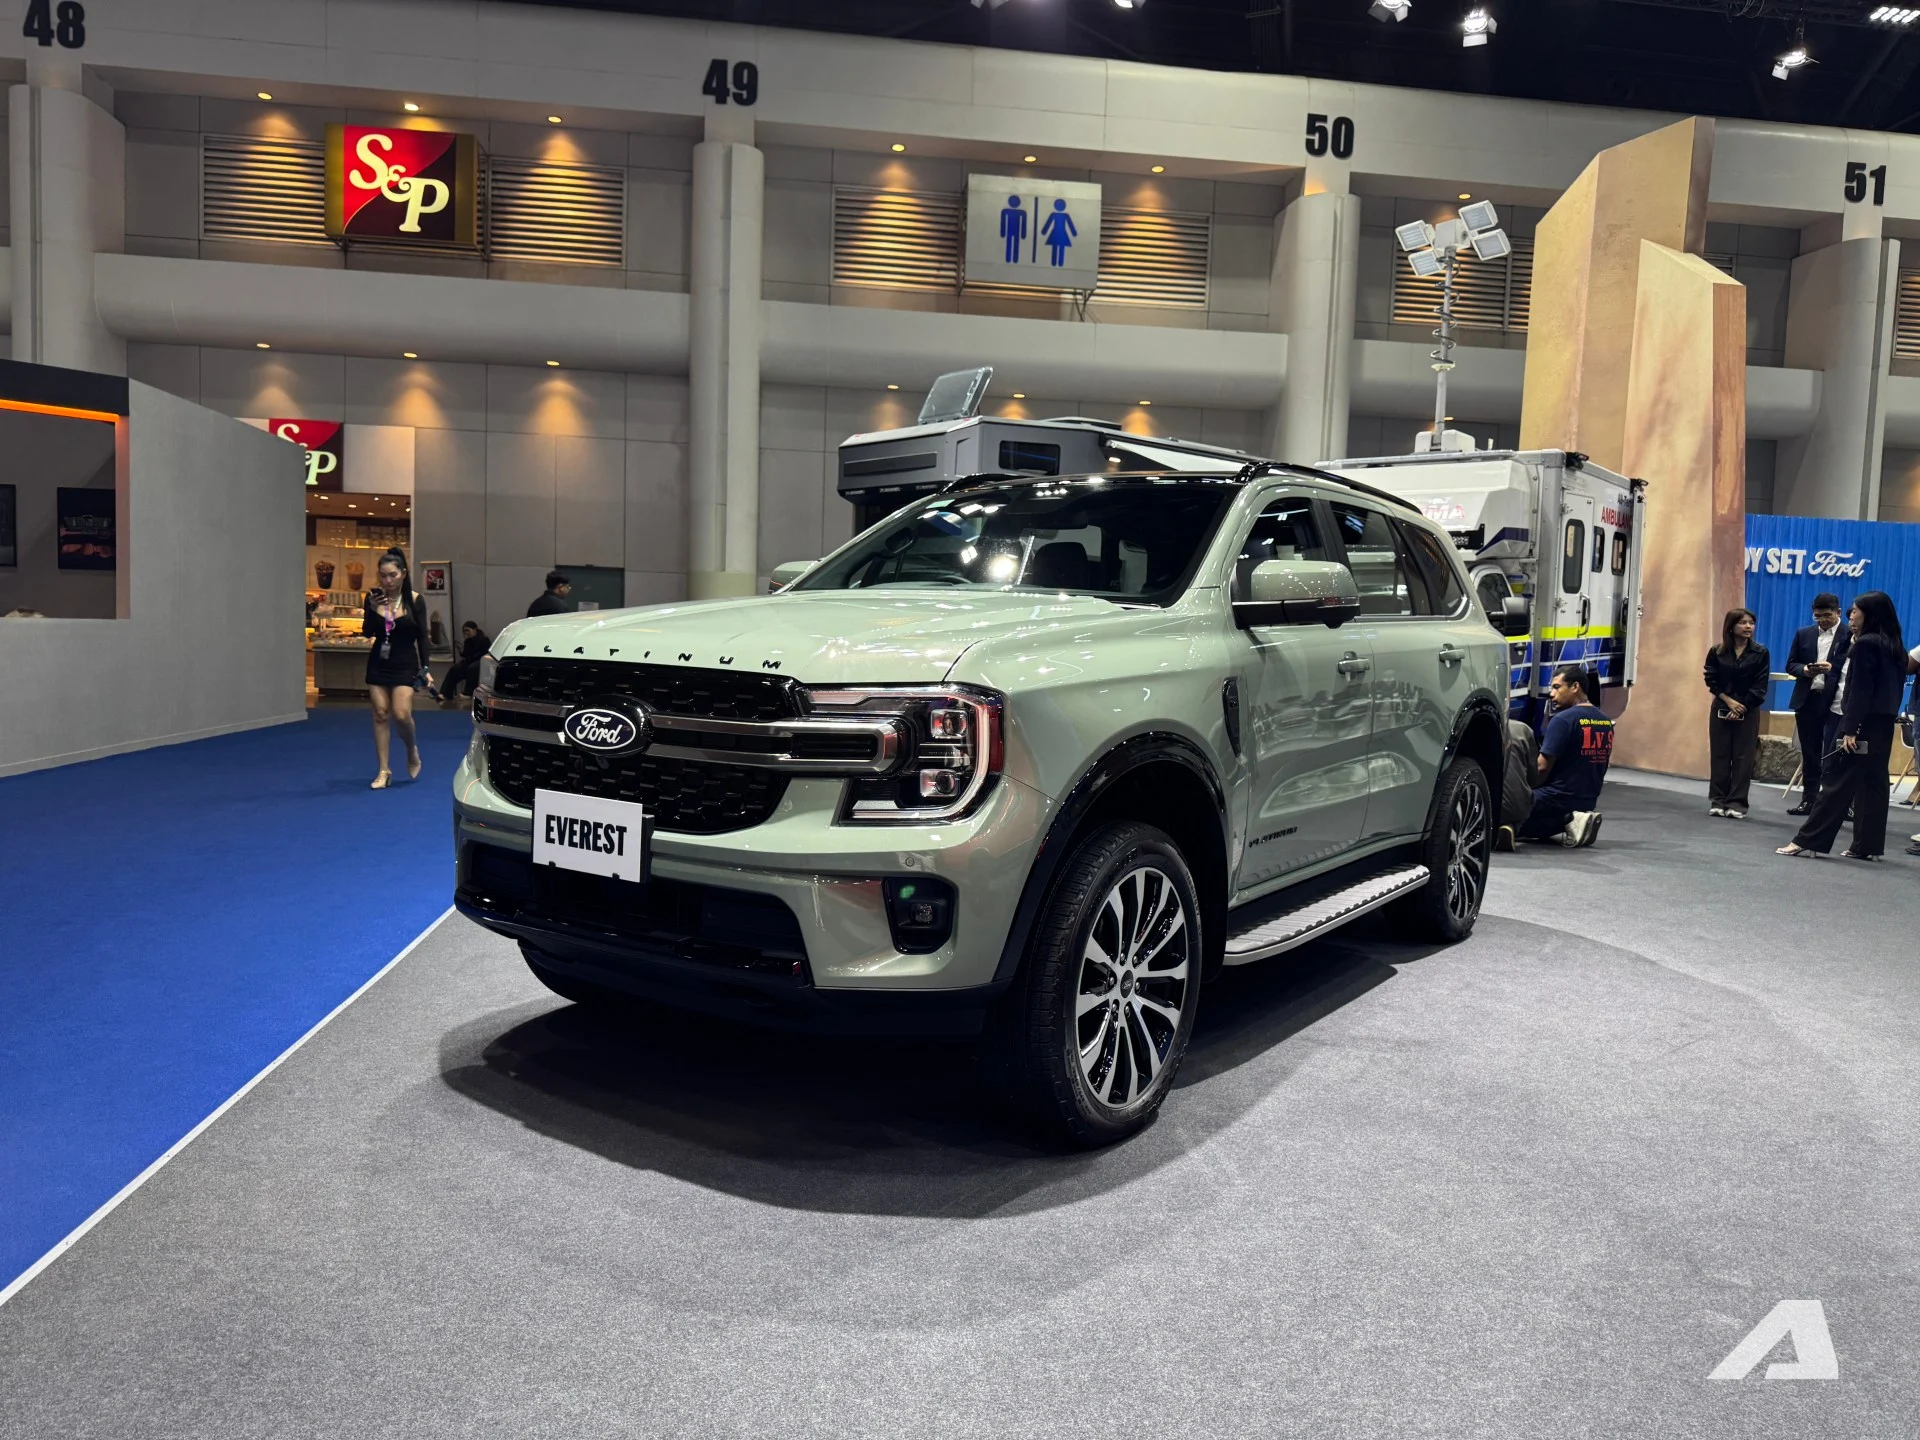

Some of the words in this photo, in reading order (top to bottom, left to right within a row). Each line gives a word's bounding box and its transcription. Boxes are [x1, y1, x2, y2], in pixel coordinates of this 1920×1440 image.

[23, 0, 85, 48] 48
[702, 58, 758, 106] 49
[1305, 112, 1354, 160] 50
[349, 133, 449, 232] S&P
[1844, 161, 1887, 207] 51
[277, 423, 338, 485] SP
[1766, 548, 1807, 574] SET
[1808, 550, 1866, 577] Ford
[515, 644, 782, 670] PLATINUM
[575, 713, 623, 744] Ford
[545, 814, 627, 856] EVEREST
